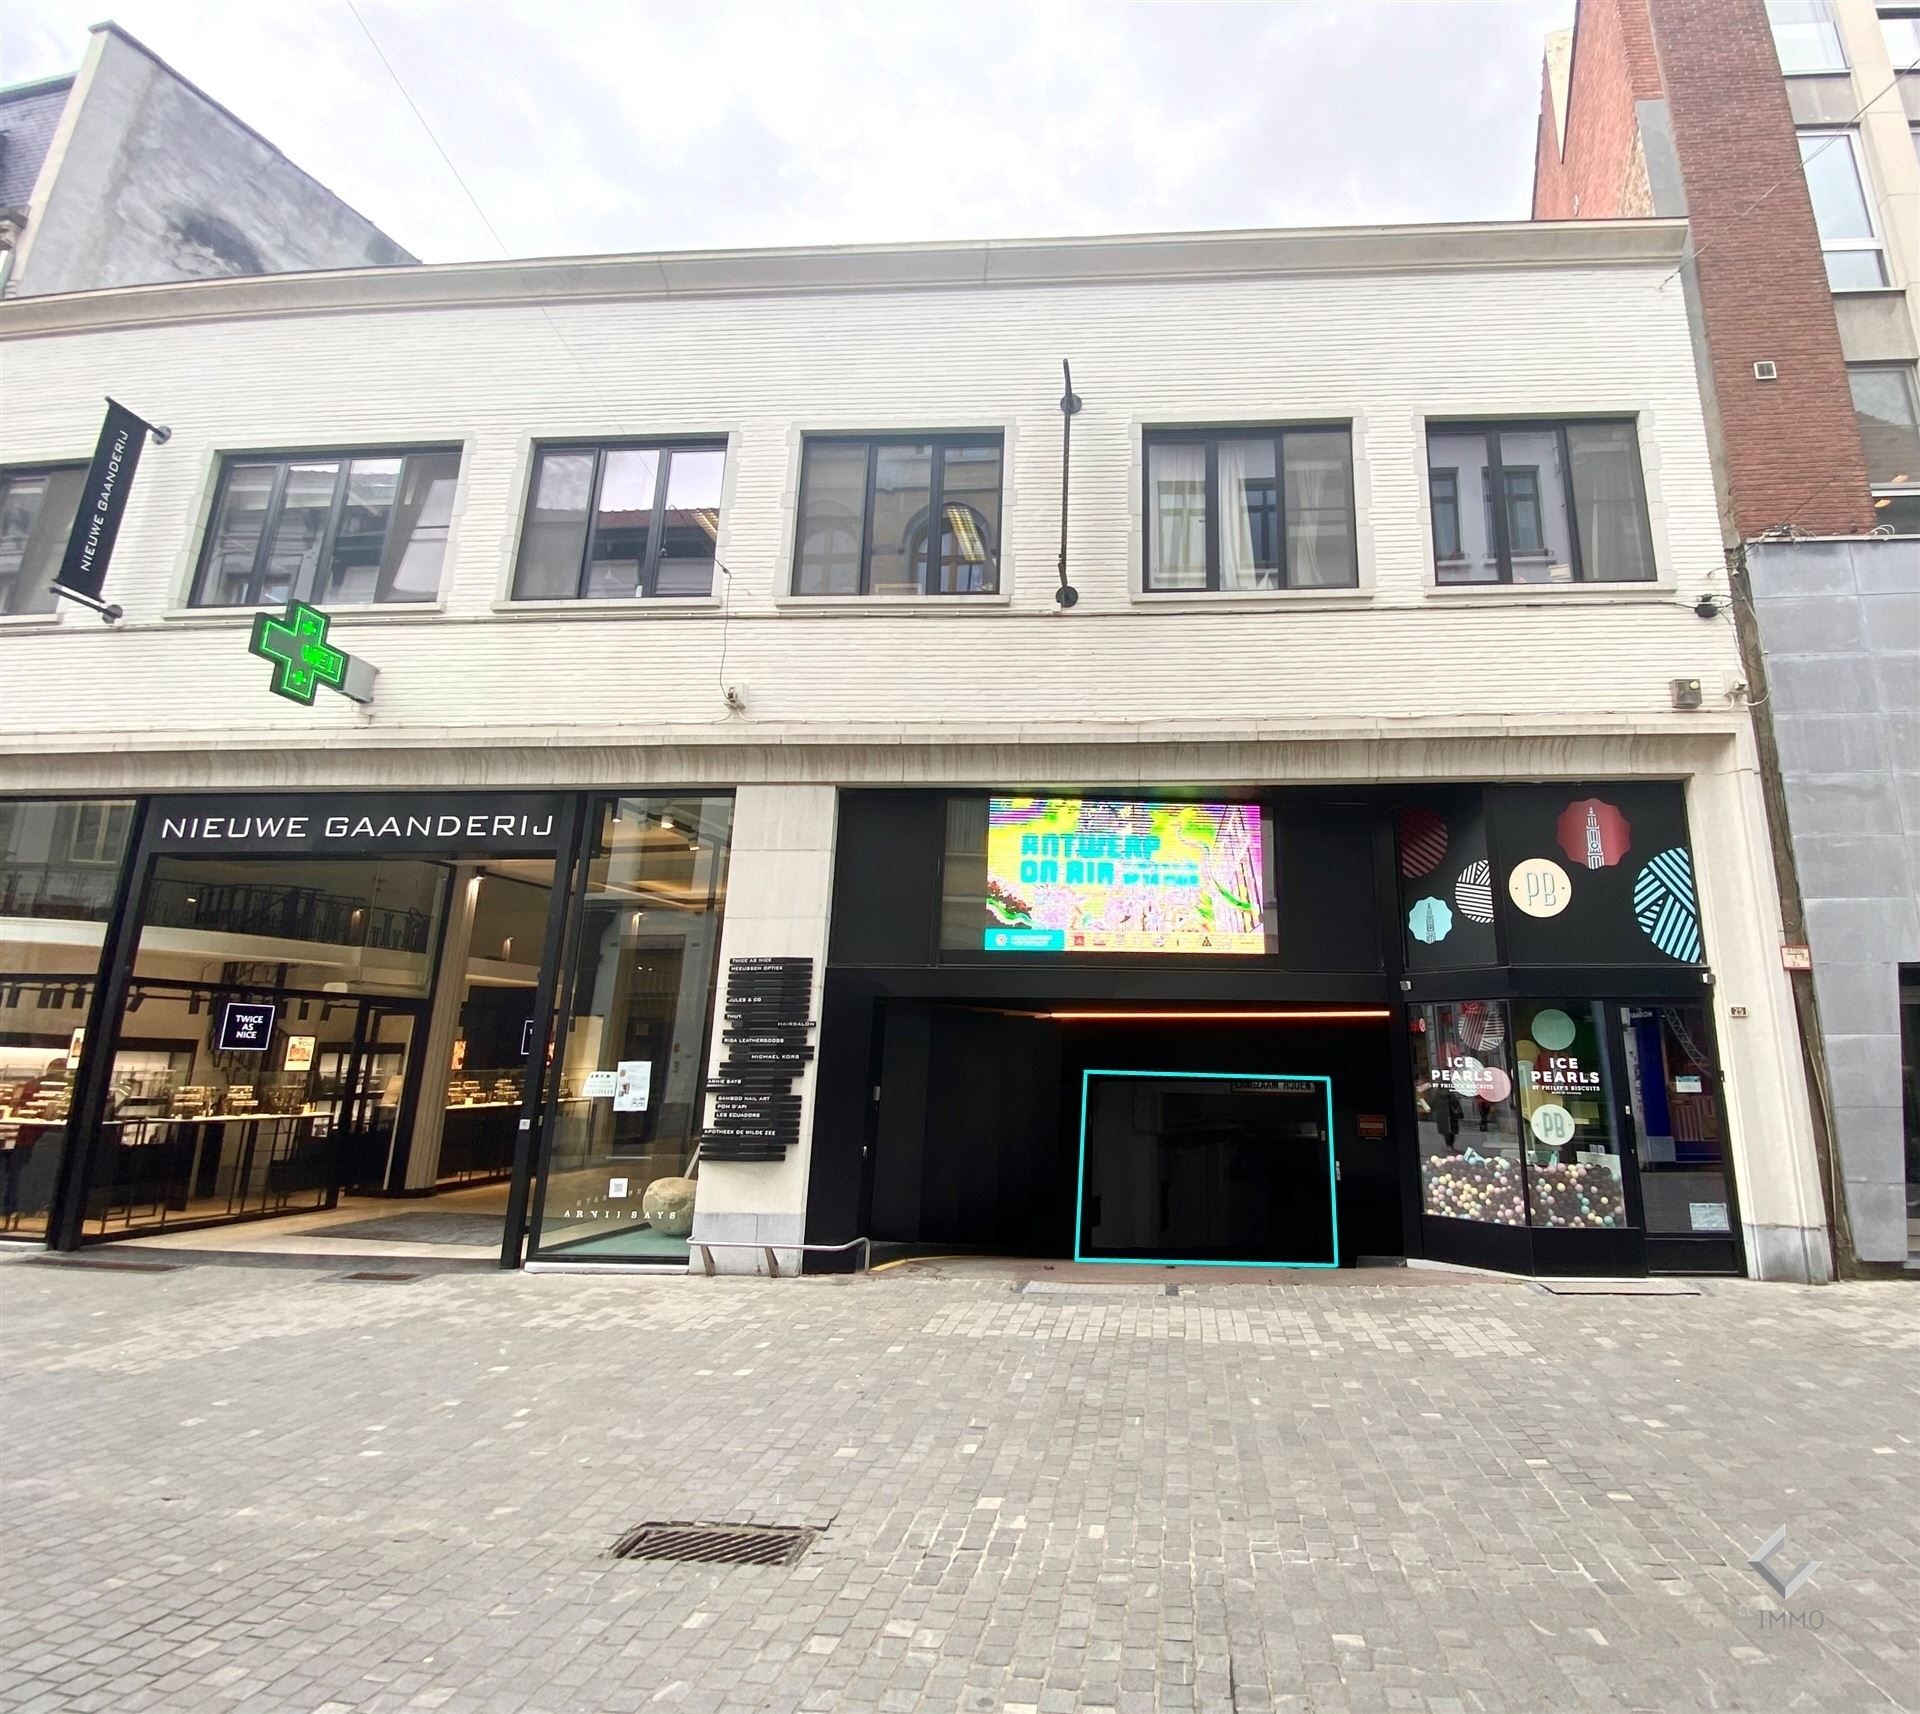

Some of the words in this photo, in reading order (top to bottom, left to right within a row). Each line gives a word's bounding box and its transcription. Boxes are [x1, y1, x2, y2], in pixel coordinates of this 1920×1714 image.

[80, 516, 104, 572] NIEUWE
[97, 430, 129, 512] GAANDERIJ
[161, 816, 310, 839] NIEUWE
[324, 814, 555, 838] GAANDERIJ
[1020, 860, 1058, 884] ON
[1525, 871, 1556, 907] PB
[235, 1014, 264, 1024] TWICE
[241, 1023, 254, 1031] AS
[236, 1031, 257, 1039] NICE
[1447, 1057, 1473, 1068] ICE
[1550, 1058, 1579, 1069] ICE
[1431, 1070, 1493, 1082] PEARLS
[1531, 1071, 1600, 1083] PEARLS
[1542, 1112, 1565, 1139] PB
[631, 1210, 676, 1220] SAYS
